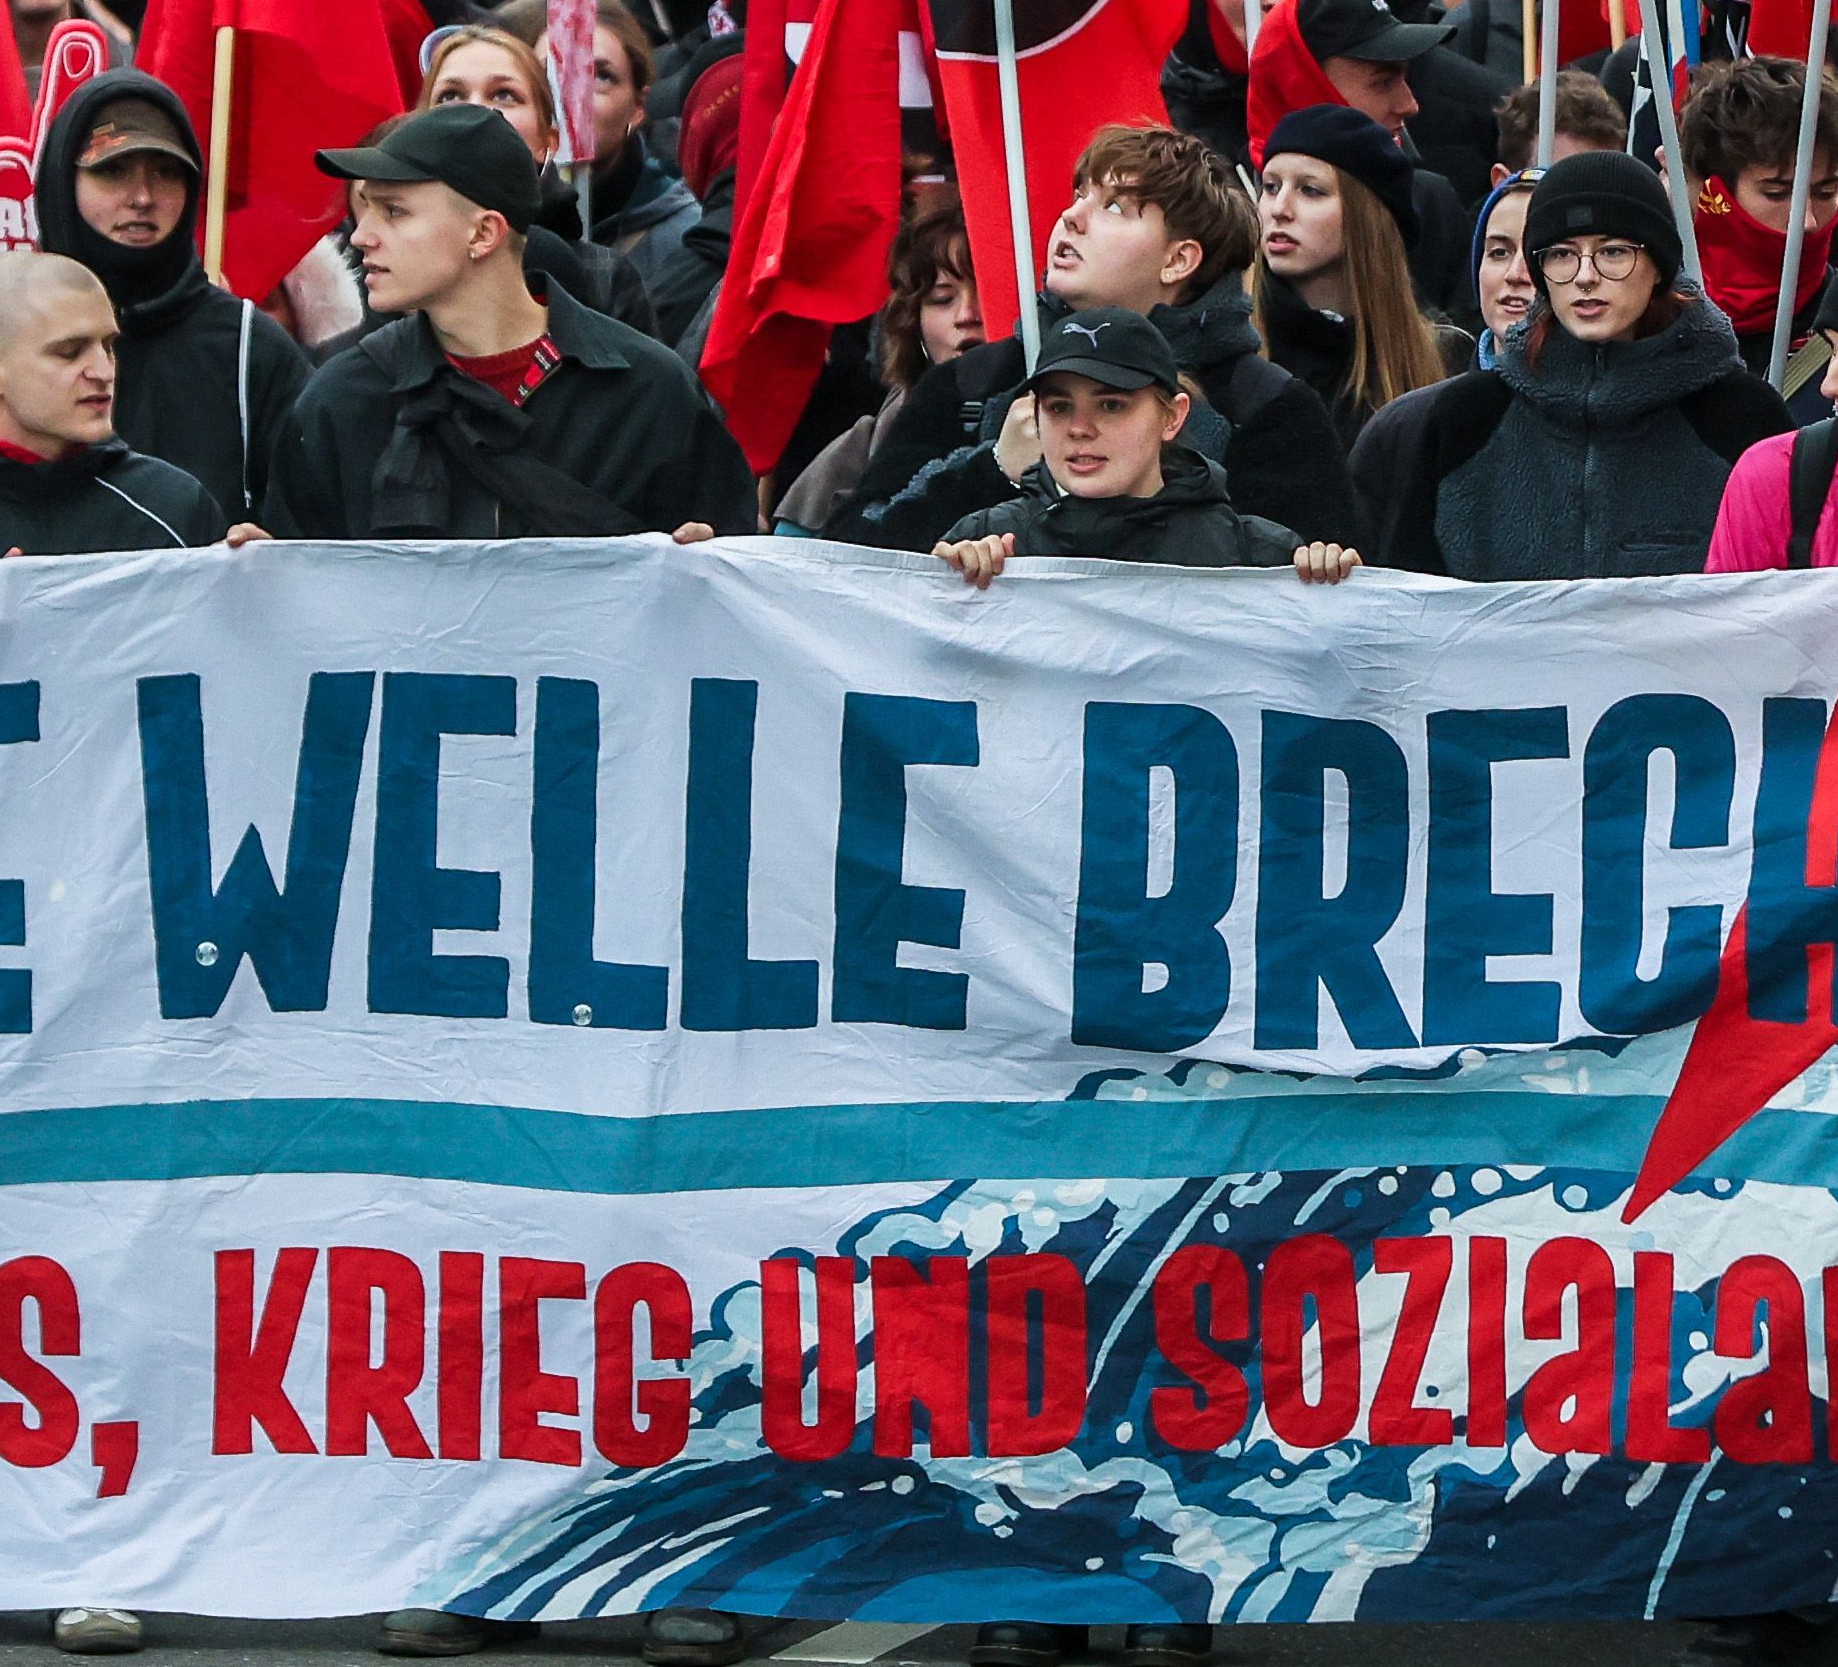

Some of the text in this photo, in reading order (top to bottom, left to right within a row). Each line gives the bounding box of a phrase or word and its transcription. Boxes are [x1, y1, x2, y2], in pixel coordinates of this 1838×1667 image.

[136, 669, 980, 1033] WELLE
[210, 1245, 693, 1469] KRIEG
[760, 1252, 1089, 1464] UND
